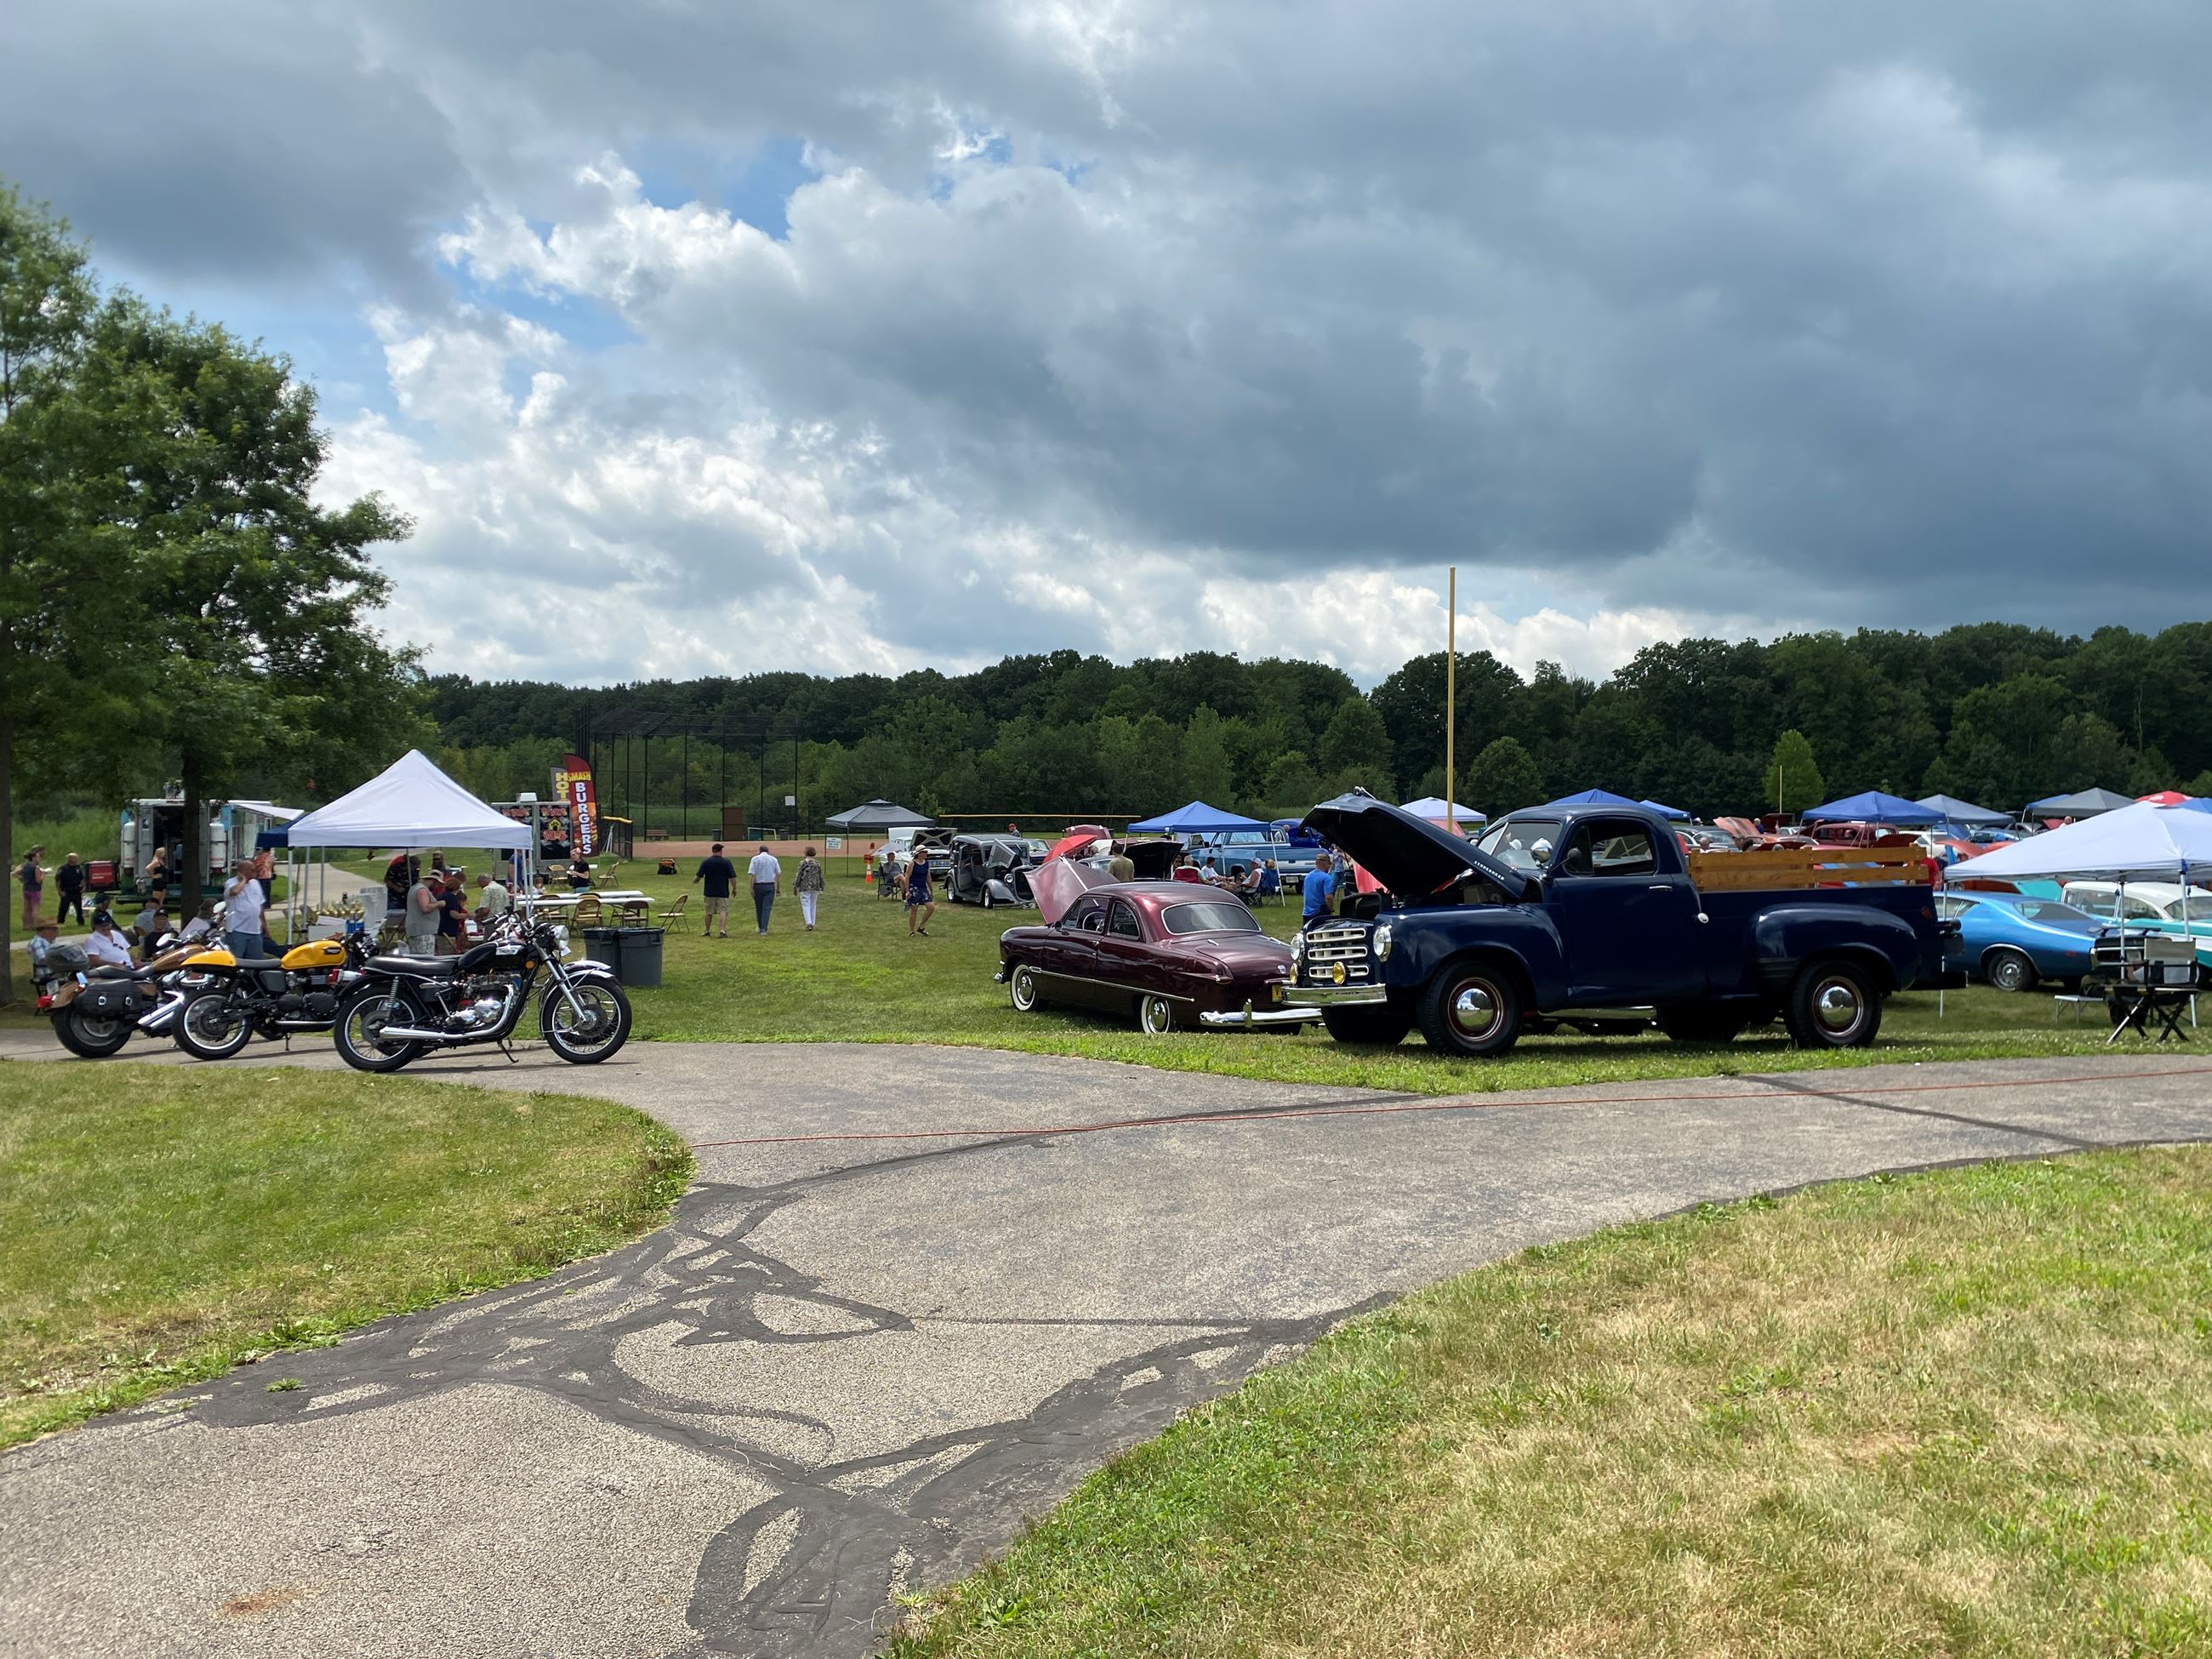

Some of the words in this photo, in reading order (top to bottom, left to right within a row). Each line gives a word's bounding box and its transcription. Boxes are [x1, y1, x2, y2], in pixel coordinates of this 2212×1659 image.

[555, 772, 569, 800] HOT
[567, 771, 591, 781] SMASH
[575, 782, 592, 854] BURGERS
